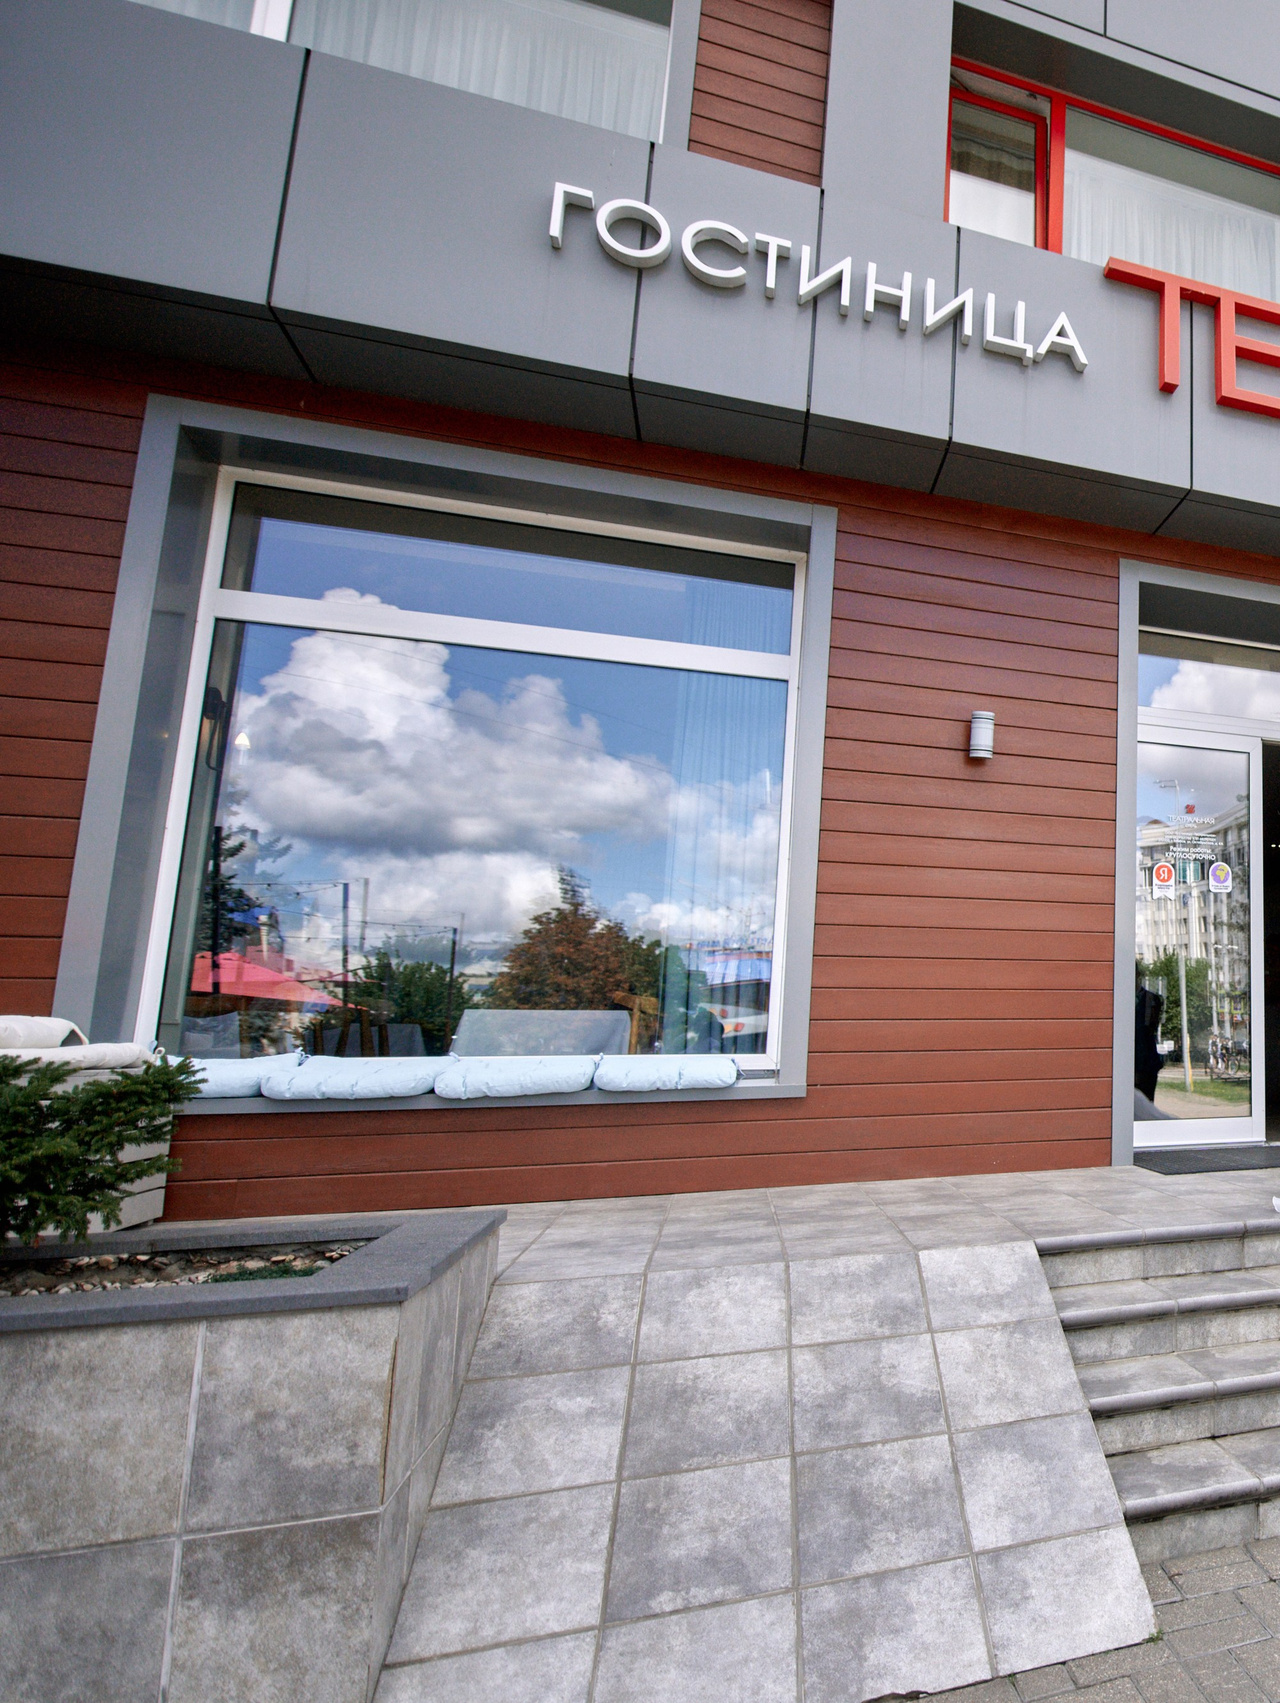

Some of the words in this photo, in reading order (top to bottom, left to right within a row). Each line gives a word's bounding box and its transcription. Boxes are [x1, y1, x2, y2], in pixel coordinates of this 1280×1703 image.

[549, 182, 1089, 373] ГОСТИНИЦА
[1168, 815, 1215, 824] ТЕАТРАЛЬНАЯ
[1165, 852, 1216, 860] КРУГЛОСУТОЧНО
